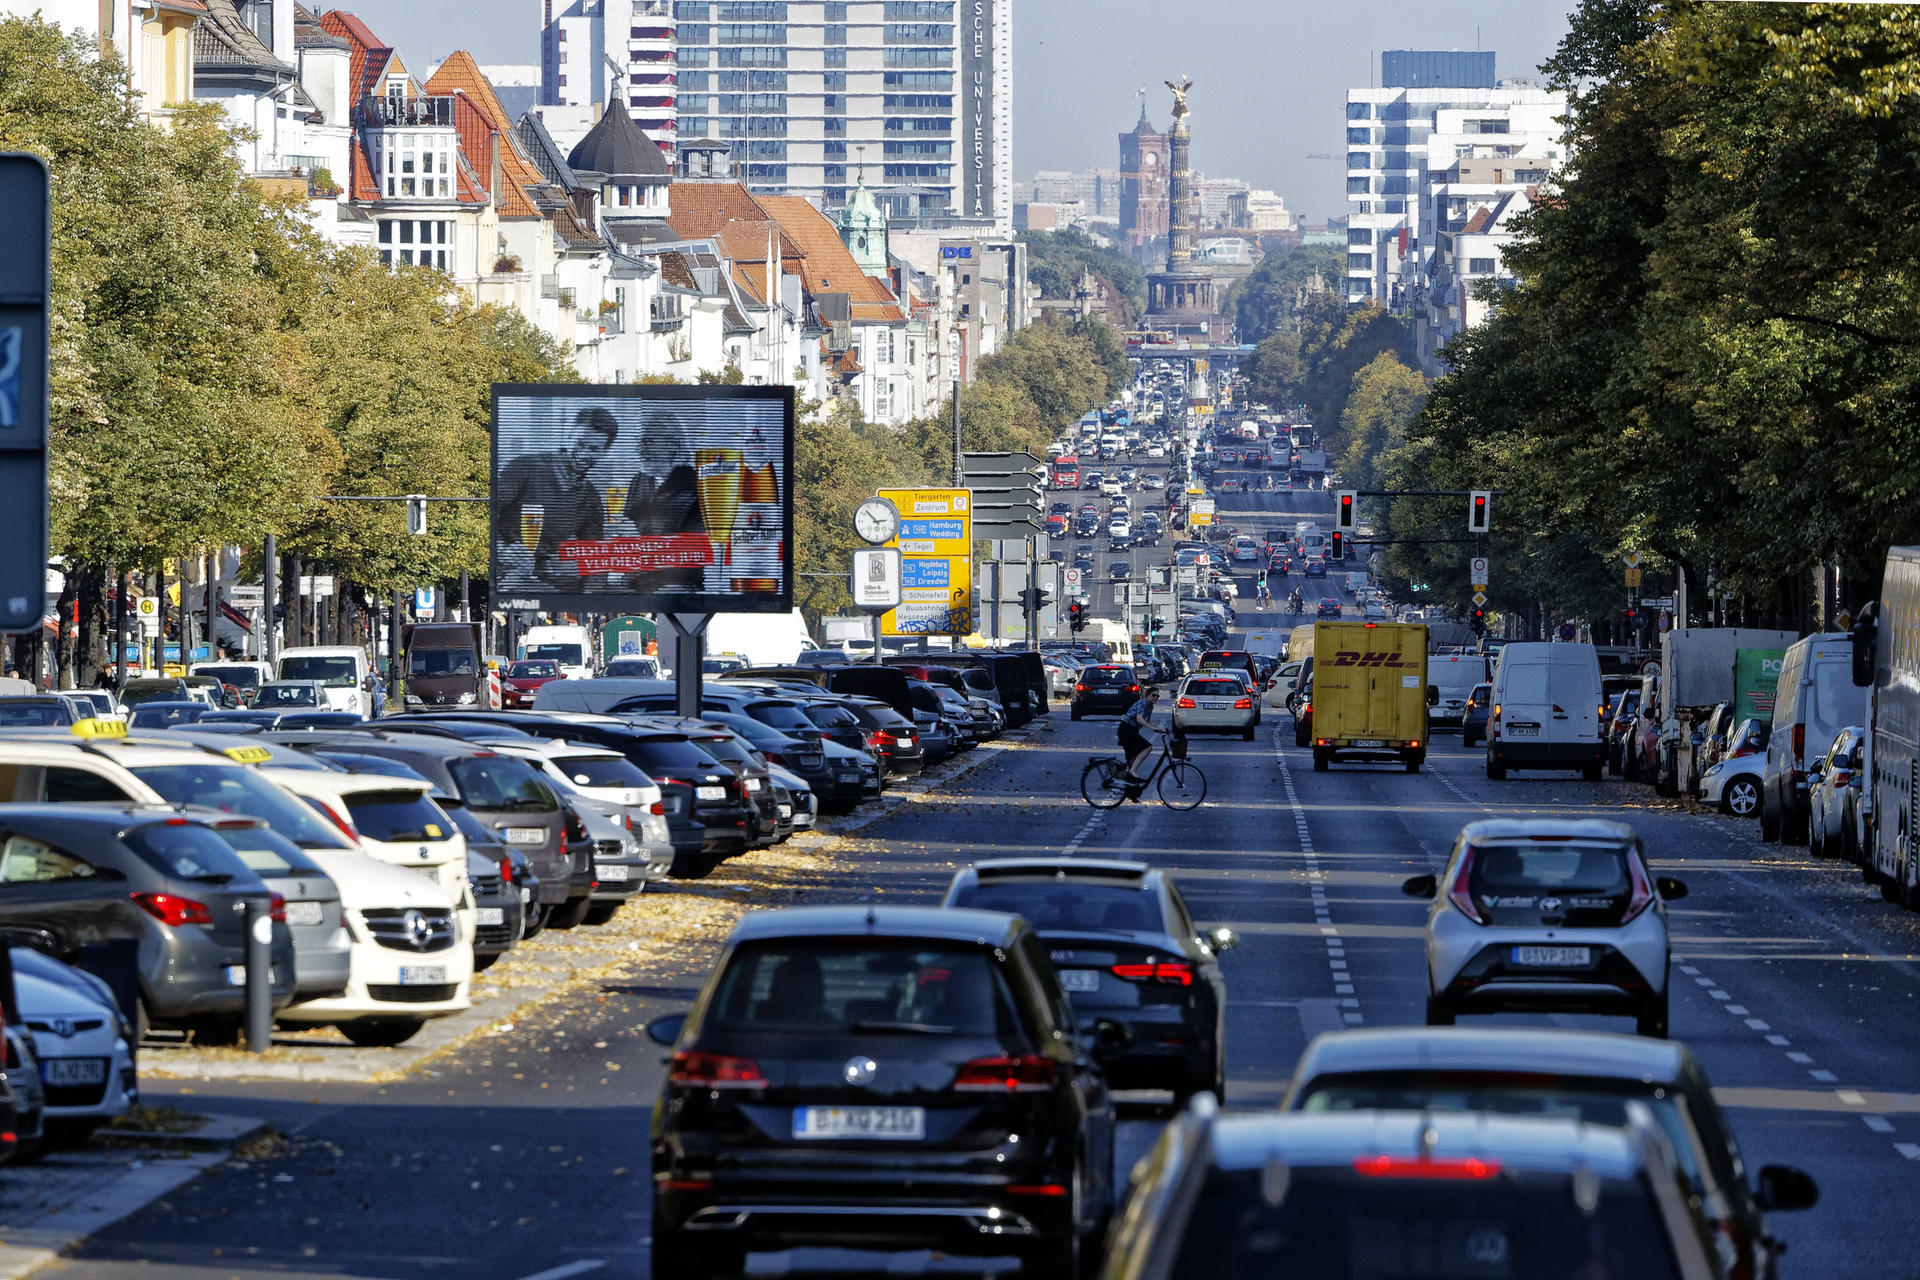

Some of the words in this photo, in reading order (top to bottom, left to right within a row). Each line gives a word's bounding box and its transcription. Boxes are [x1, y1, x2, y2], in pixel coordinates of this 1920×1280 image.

[914, 493, 951, 501] Tiergarten
[915, 503, 947, 511] Zentrum
[929, 521, 962, 531] Hamburg
[929, 530, 960, 539] Wedding
[913, 542, 932, 551] Tegel
[922, 569, 948, 578] Leipzig
[917, 577, 948, 585] Dresden
[418, 587, 435, 608] U
[908, 591, 948, 600] Schönefeld
[511, 599, 540, 609] Wall
[905, 605, 948, 613] Busbahnhof
[1334, 651, 1405, 668] DHL
